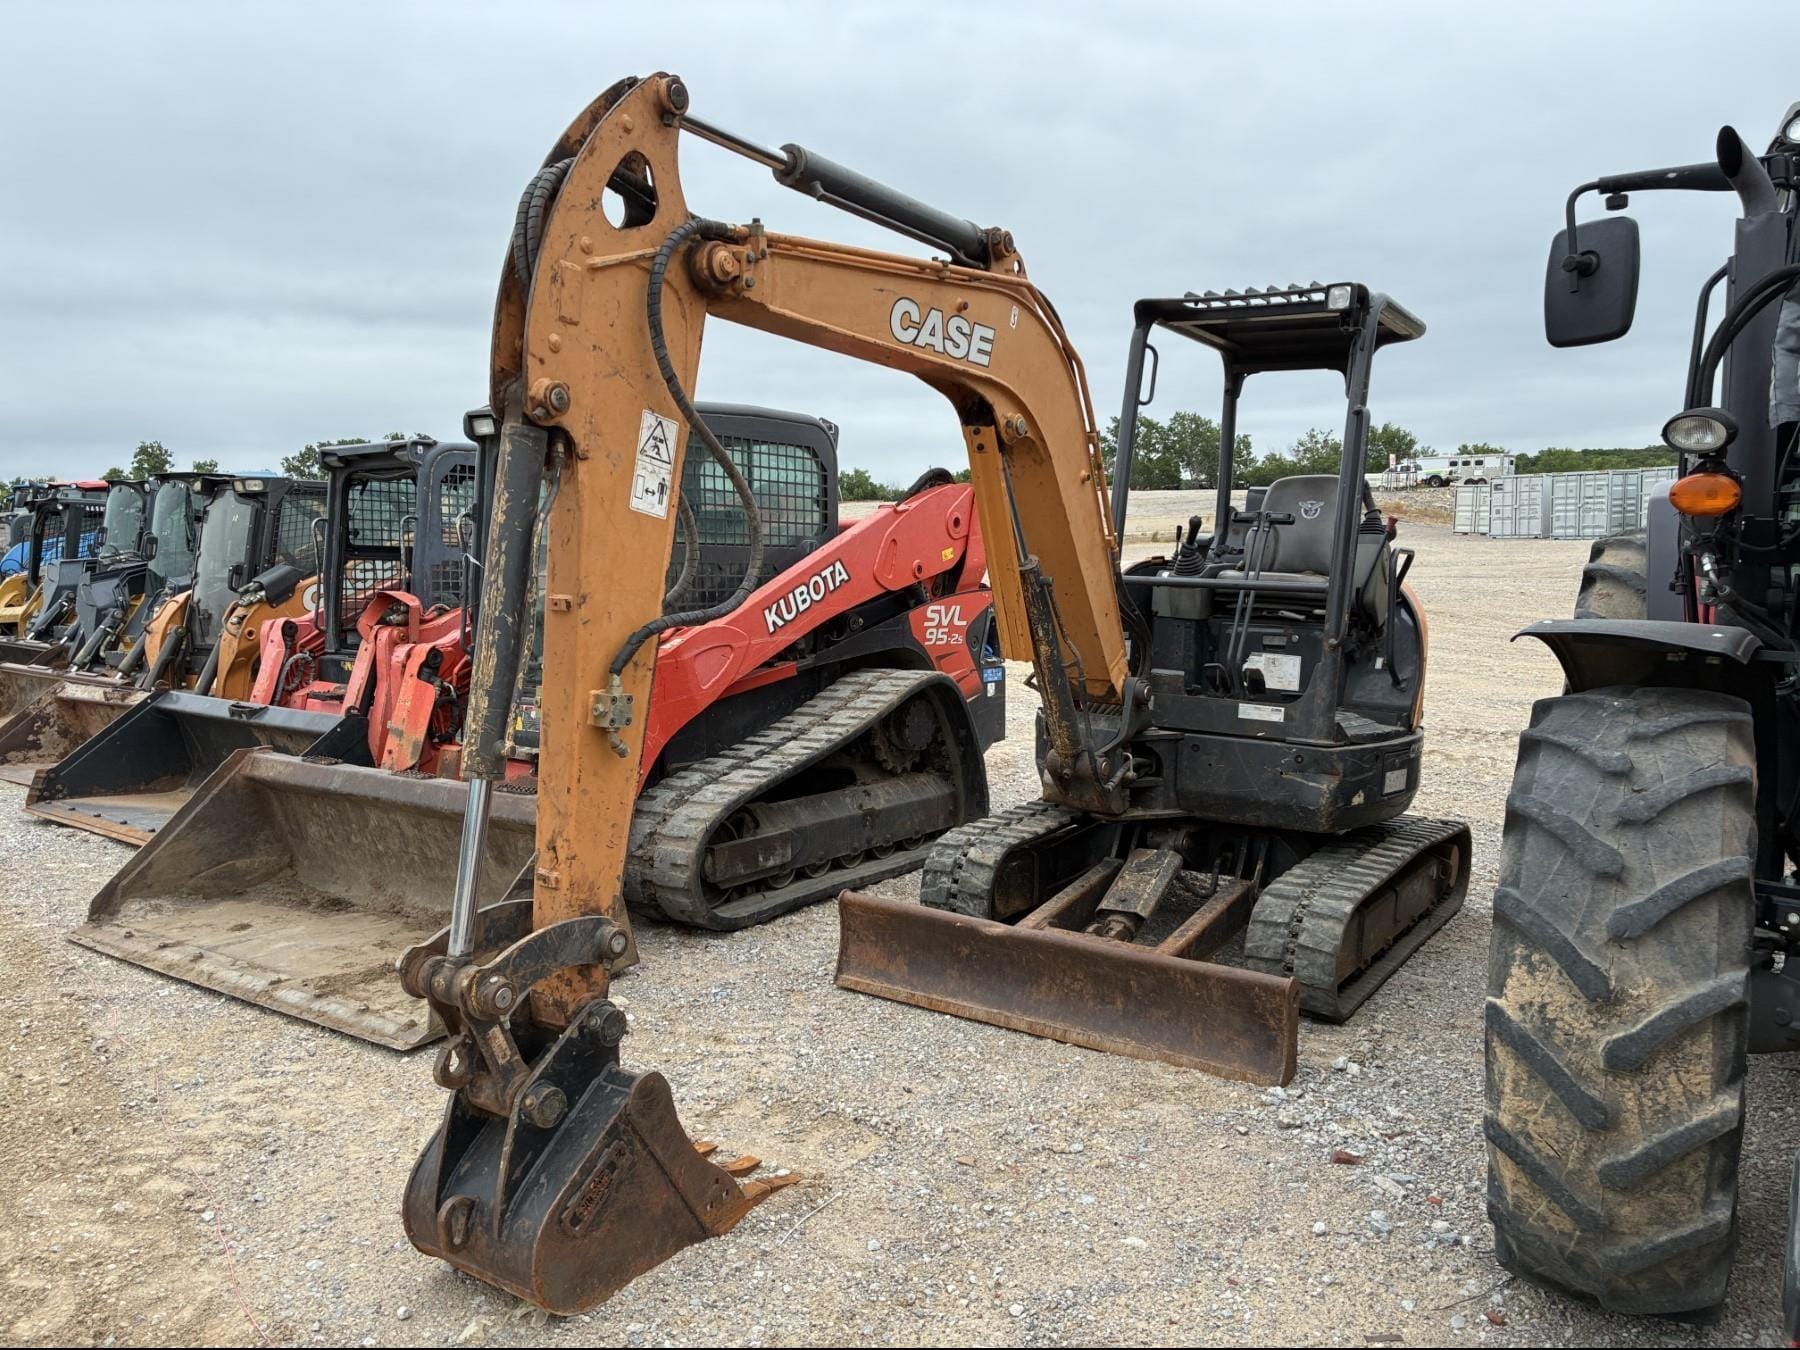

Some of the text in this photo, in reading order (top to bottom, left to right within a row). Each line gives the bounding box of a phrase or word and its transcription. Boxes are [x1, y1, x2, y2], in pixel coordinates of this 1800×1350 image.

[889, 296, 996, 368] CASE
[763, 559, 851, 634] KUBOTA
[923, 605, 967, 627] SVL
